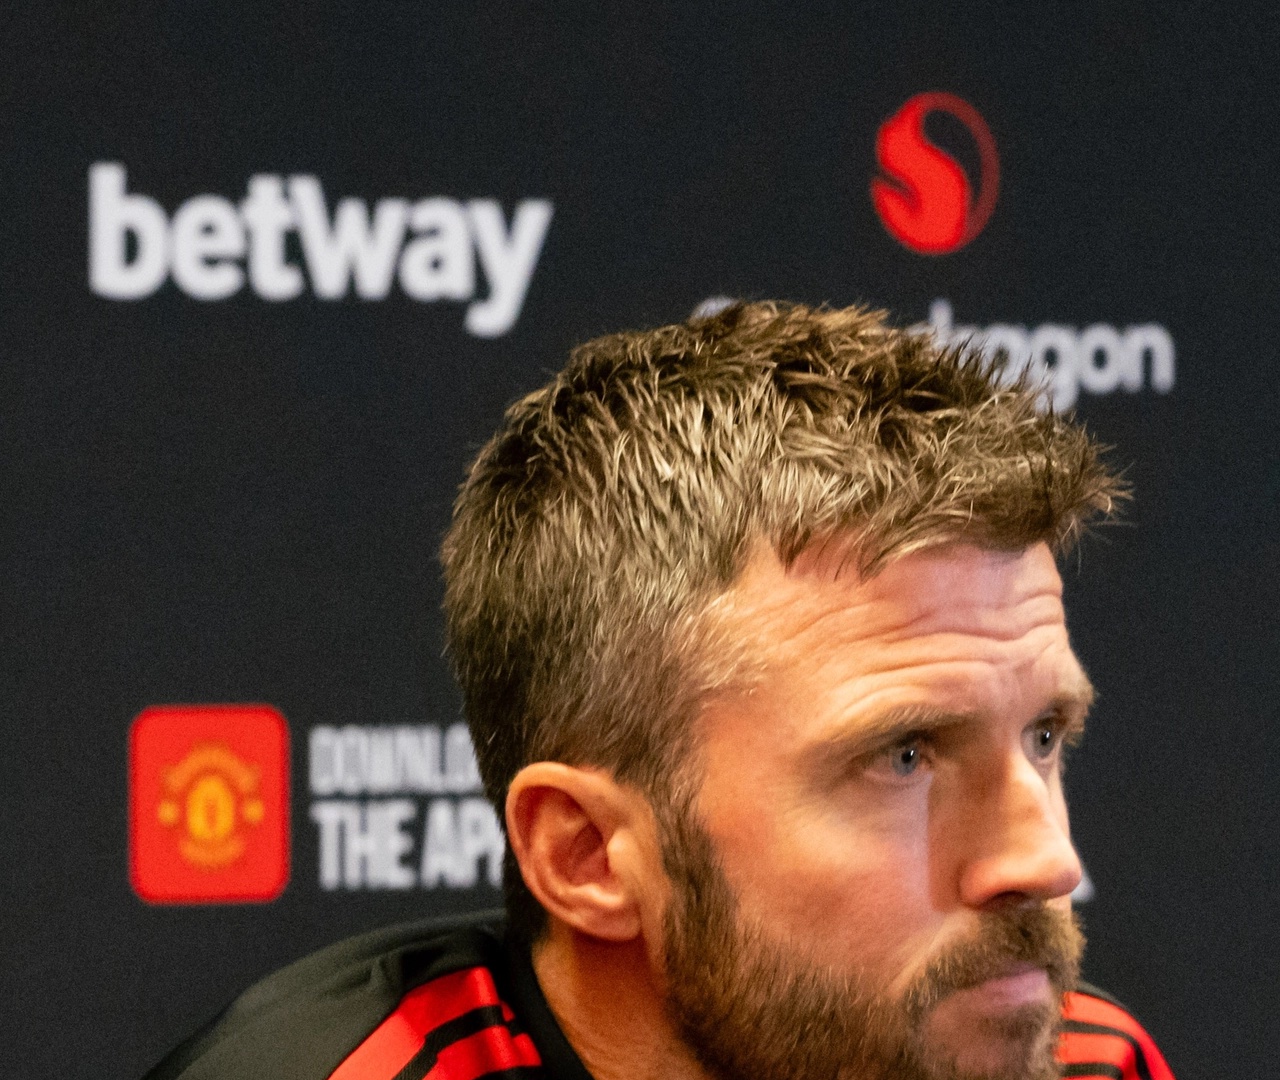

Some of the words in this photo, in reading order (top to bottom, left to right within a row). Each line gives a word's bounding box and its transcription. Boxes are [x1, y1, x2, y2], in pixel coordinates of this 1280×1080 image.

[87, 161, 553, 338] betway
[308, 722, 485, 795] DOWNLO
[310, 797, 417, 892] THE
